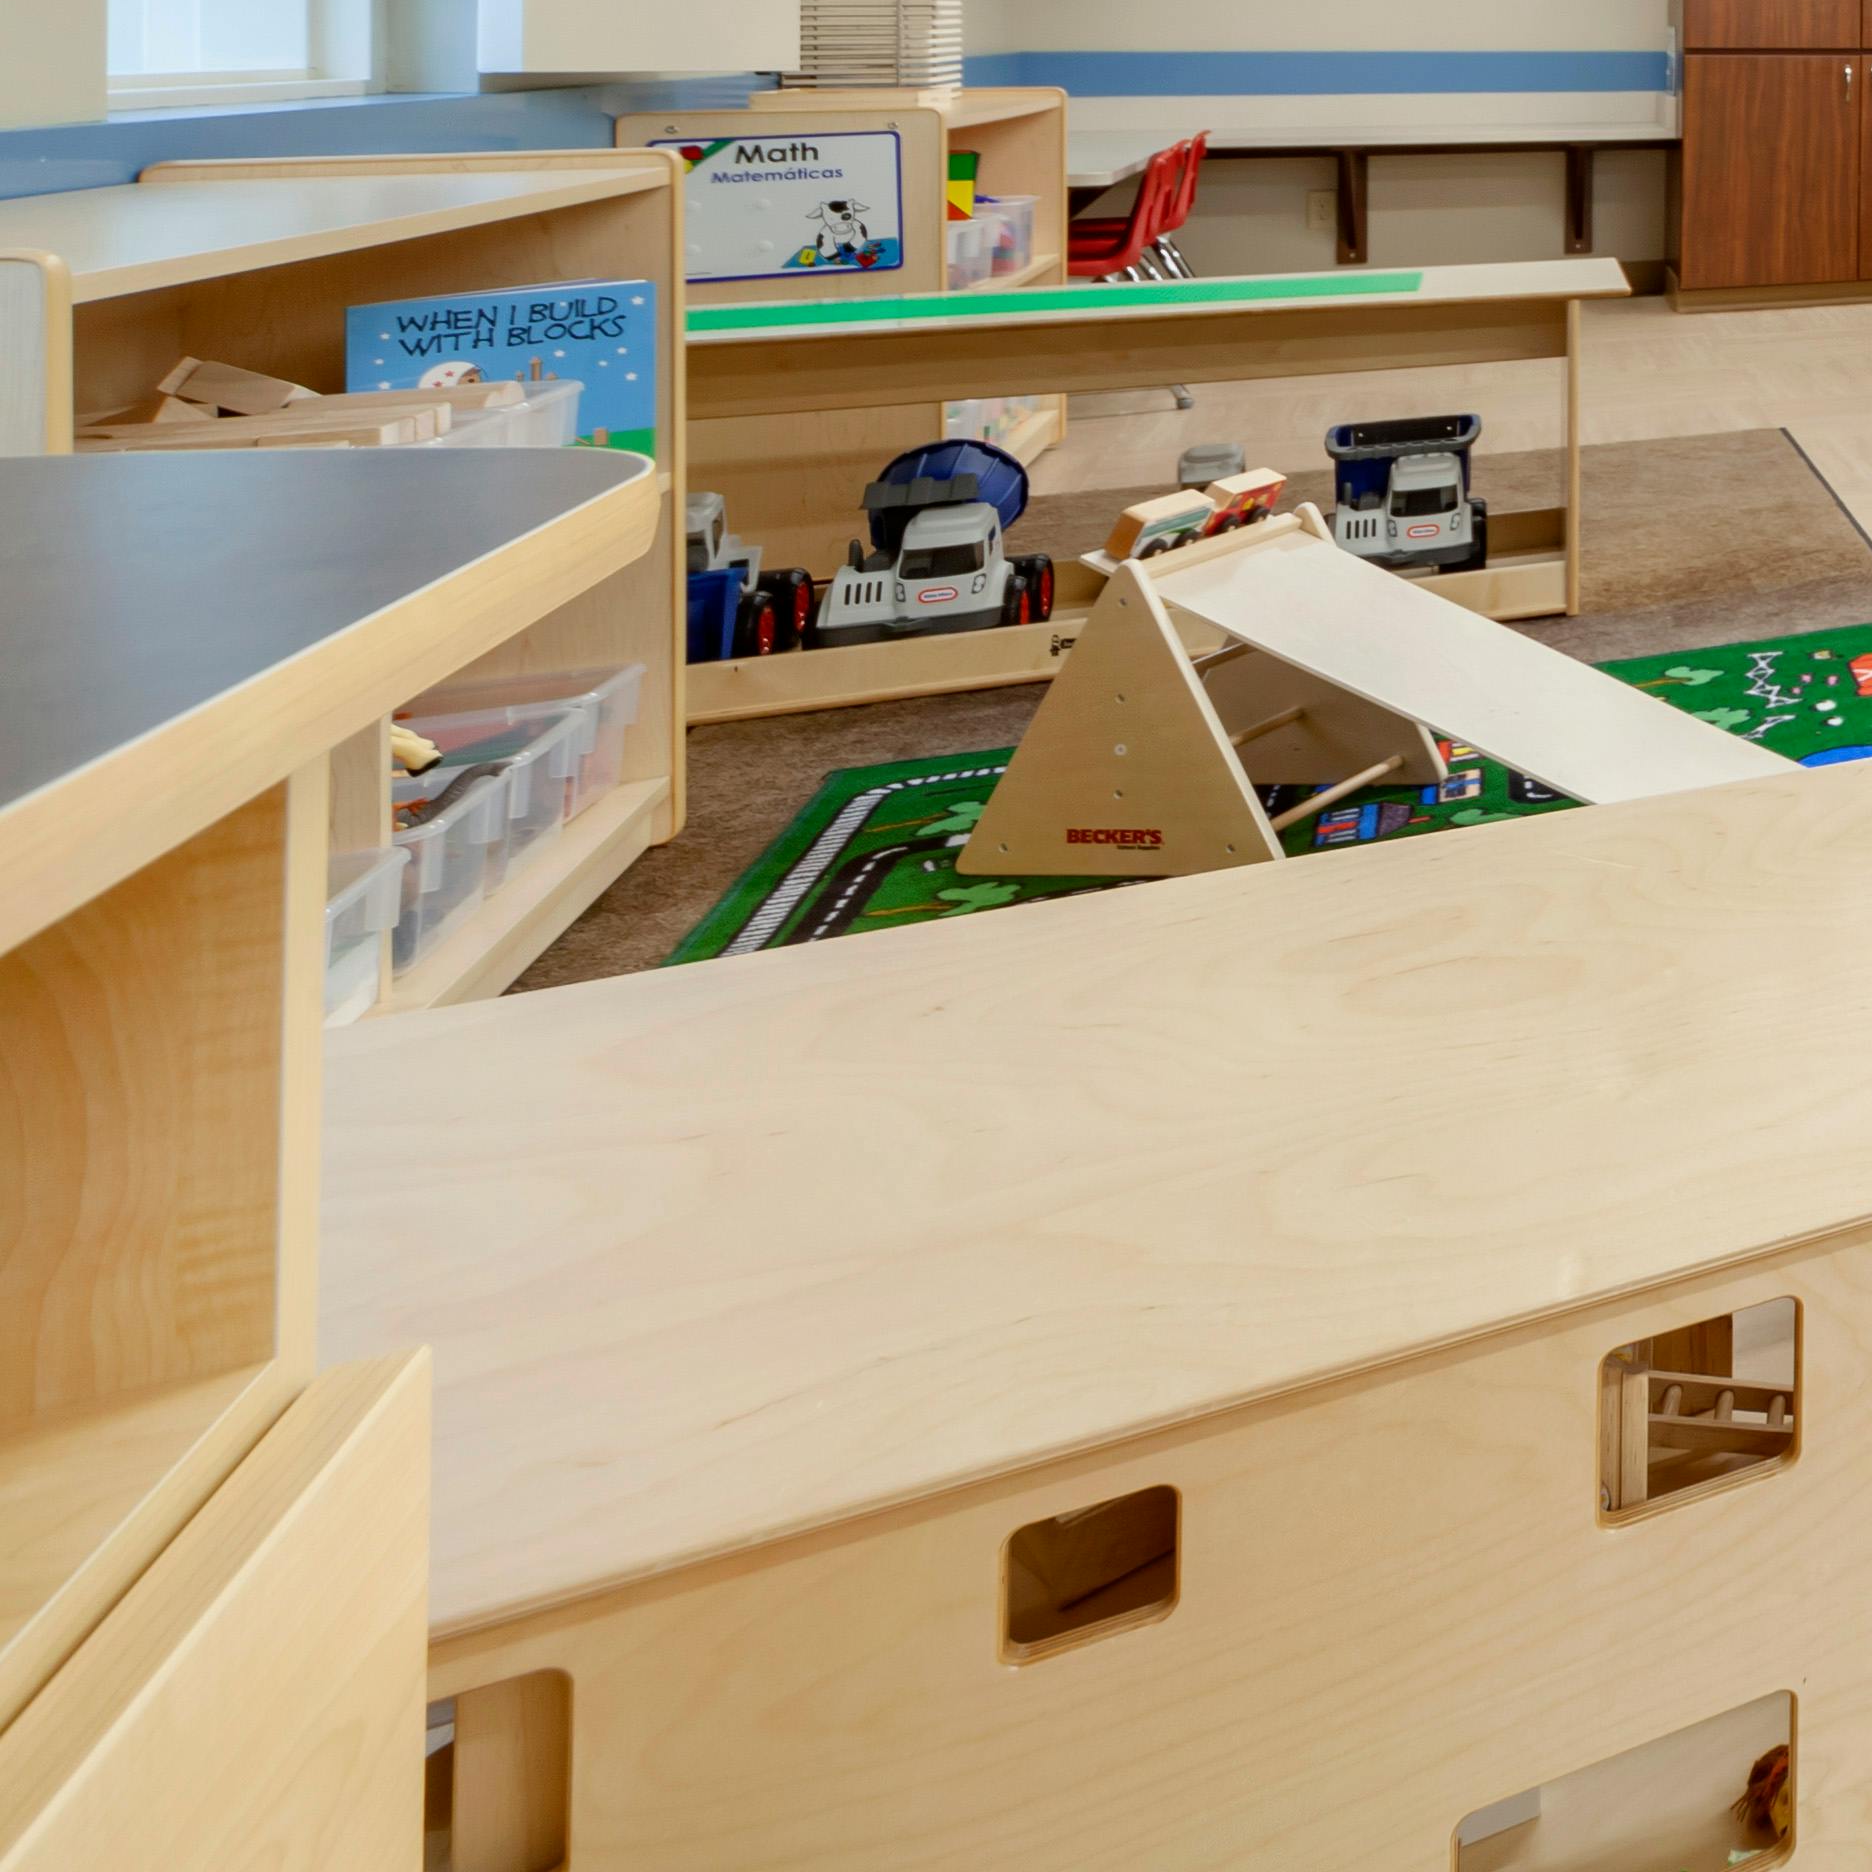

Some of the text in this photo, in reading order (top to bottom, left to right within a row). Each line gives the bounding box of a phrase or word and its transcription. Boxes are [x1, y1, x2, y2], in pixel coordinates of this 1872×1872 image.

[734, 141, 820, 165] Math
[710, 166, 844, 185] Matemáticas
[396, 296, 620, 334] WHEN I BUILD
[400, 315, 627, 358] WITH BLOCKS
[1066, 829, 1163, 844] BECKER'S
